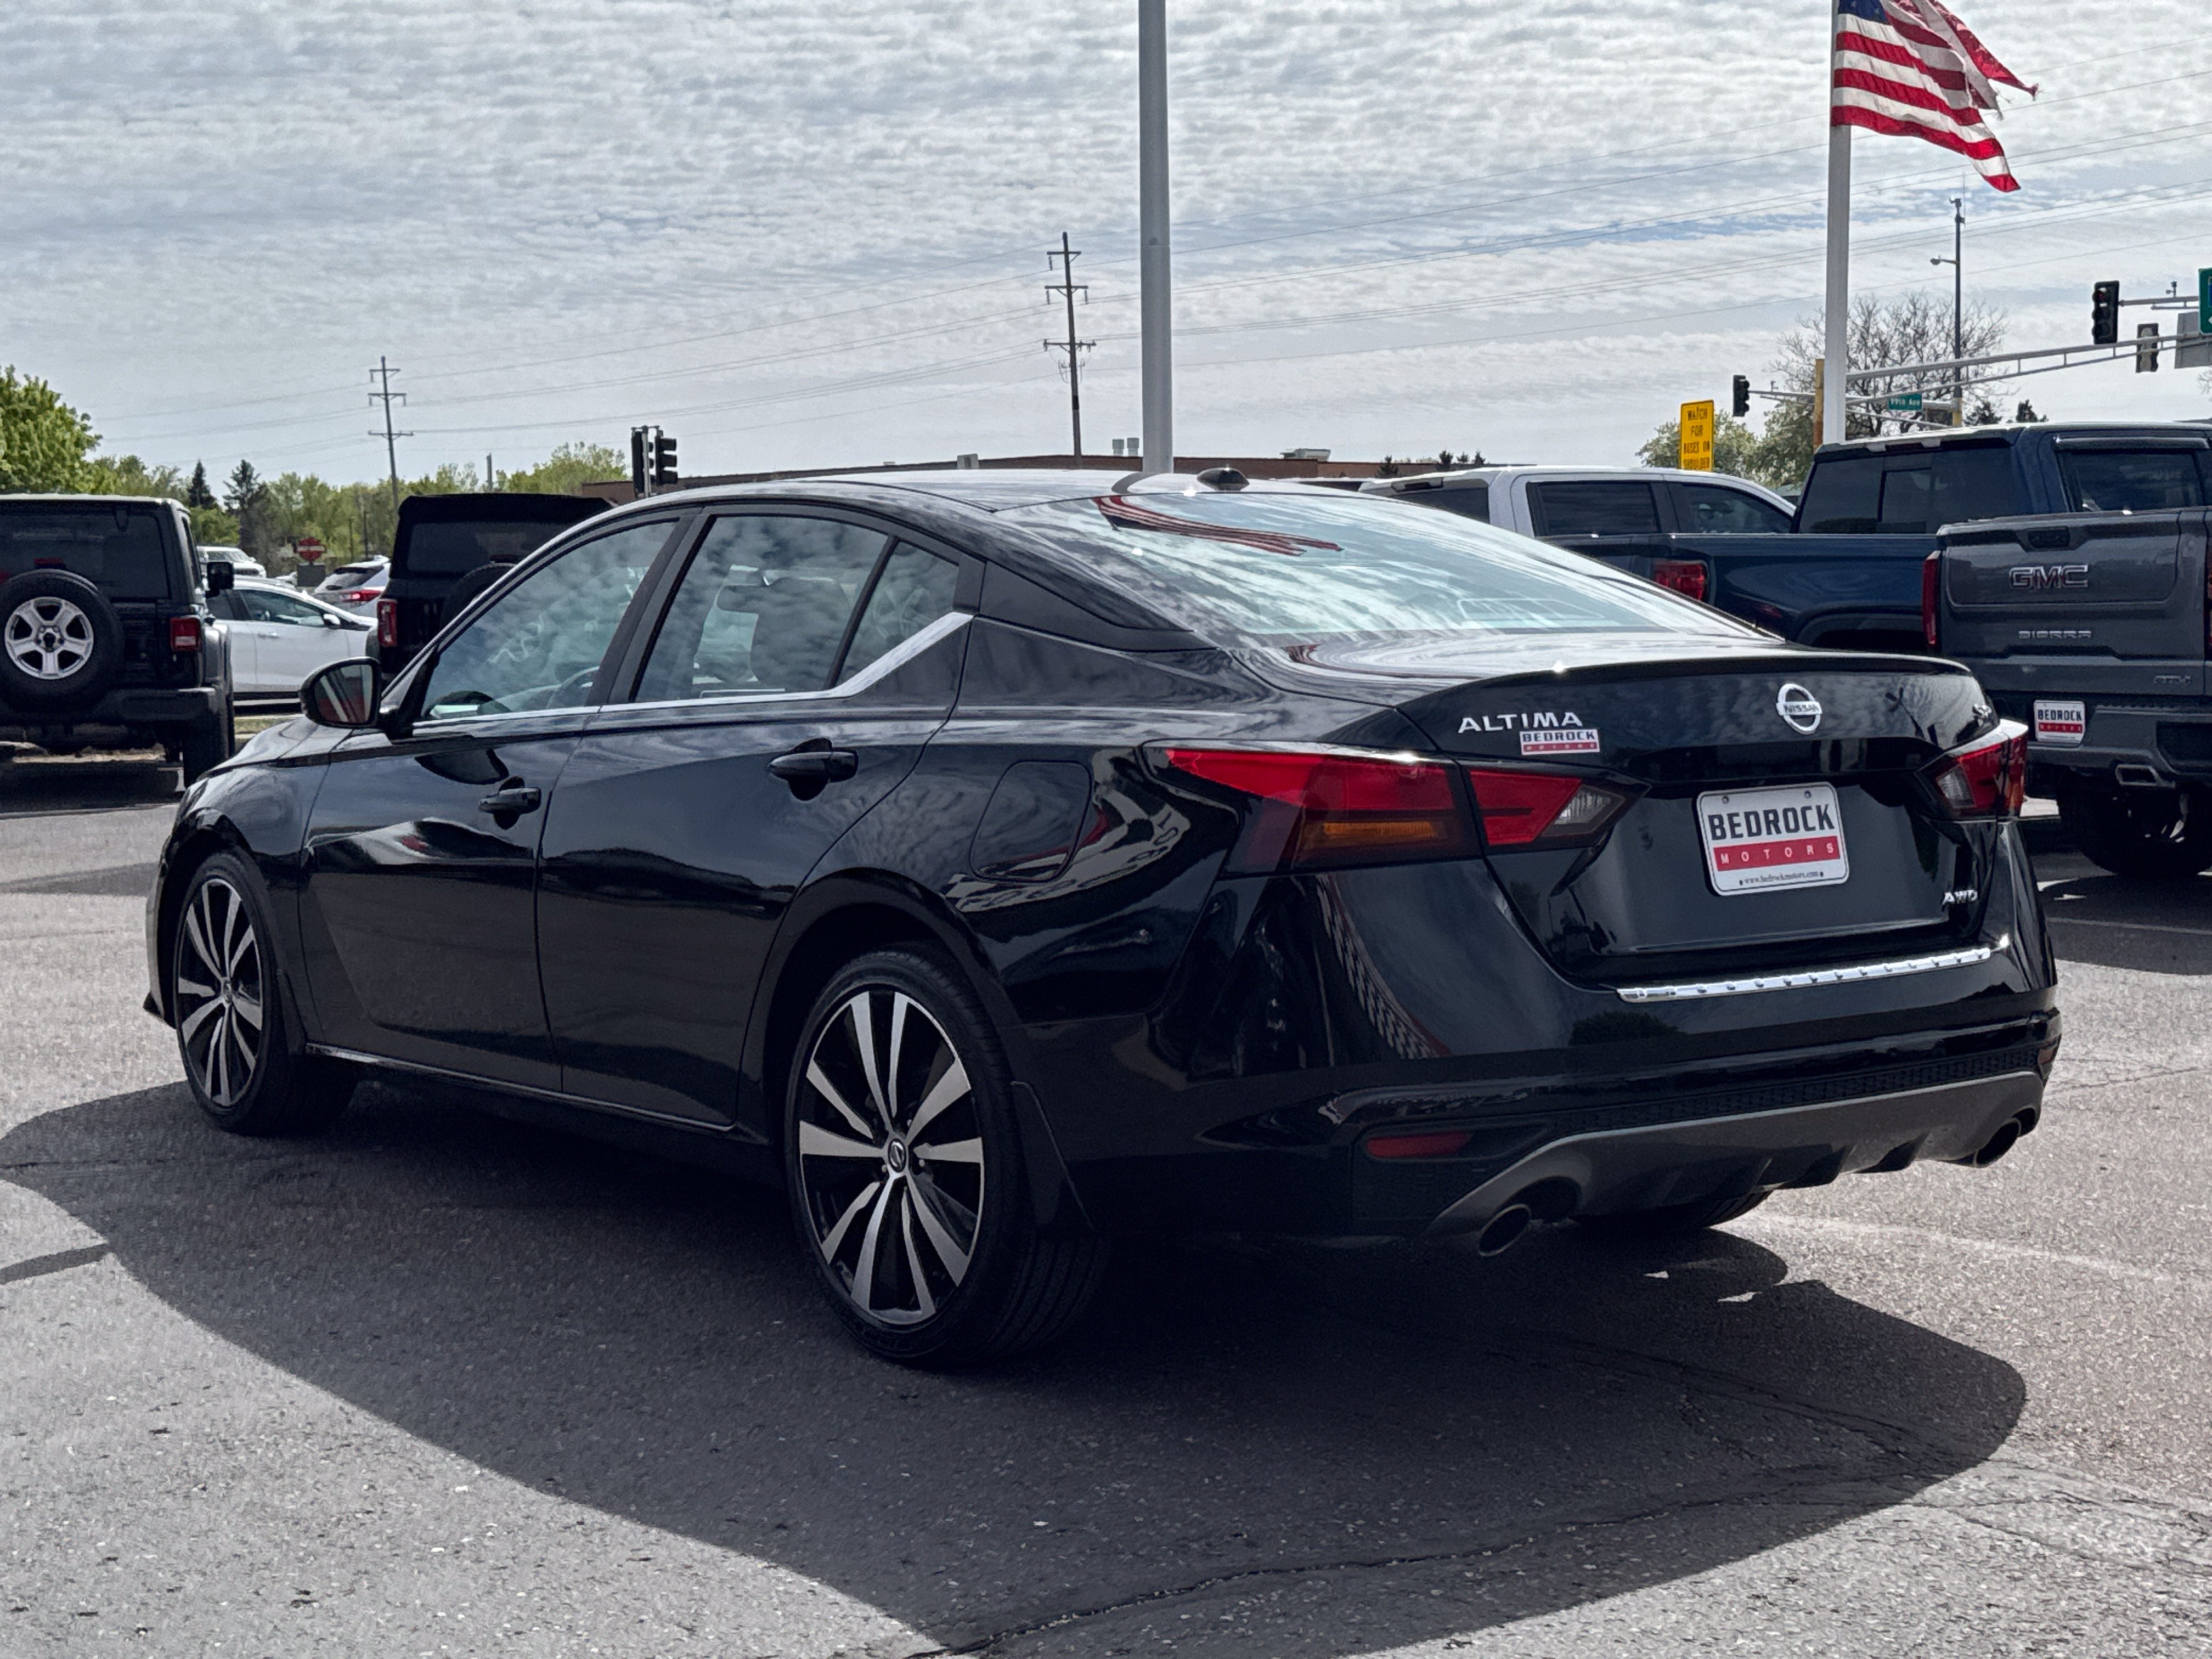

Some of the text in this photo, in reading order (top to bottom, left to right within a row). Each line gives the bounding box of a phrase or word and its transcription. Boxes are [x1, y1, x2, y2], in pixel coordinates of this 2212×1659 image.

[1691, 424, 1703, 437] FOR
[2009, 565, 2088, 592] GMC
[2018, 630, 2092, 639] SIERRA
[1784, 704, 1819, 713] NISSAN
[2038, 709, 2082, 721] BEDROCK
[1458, 712, 1583, 733] ALTIMA
[1522, 731, 1595, 742] BEDROCK
[1707, 804, 1835, 840] BEDROCK
[1720, 843, 1833, 864] MOTORS
[1942, 889, 1978, 905] AWD
